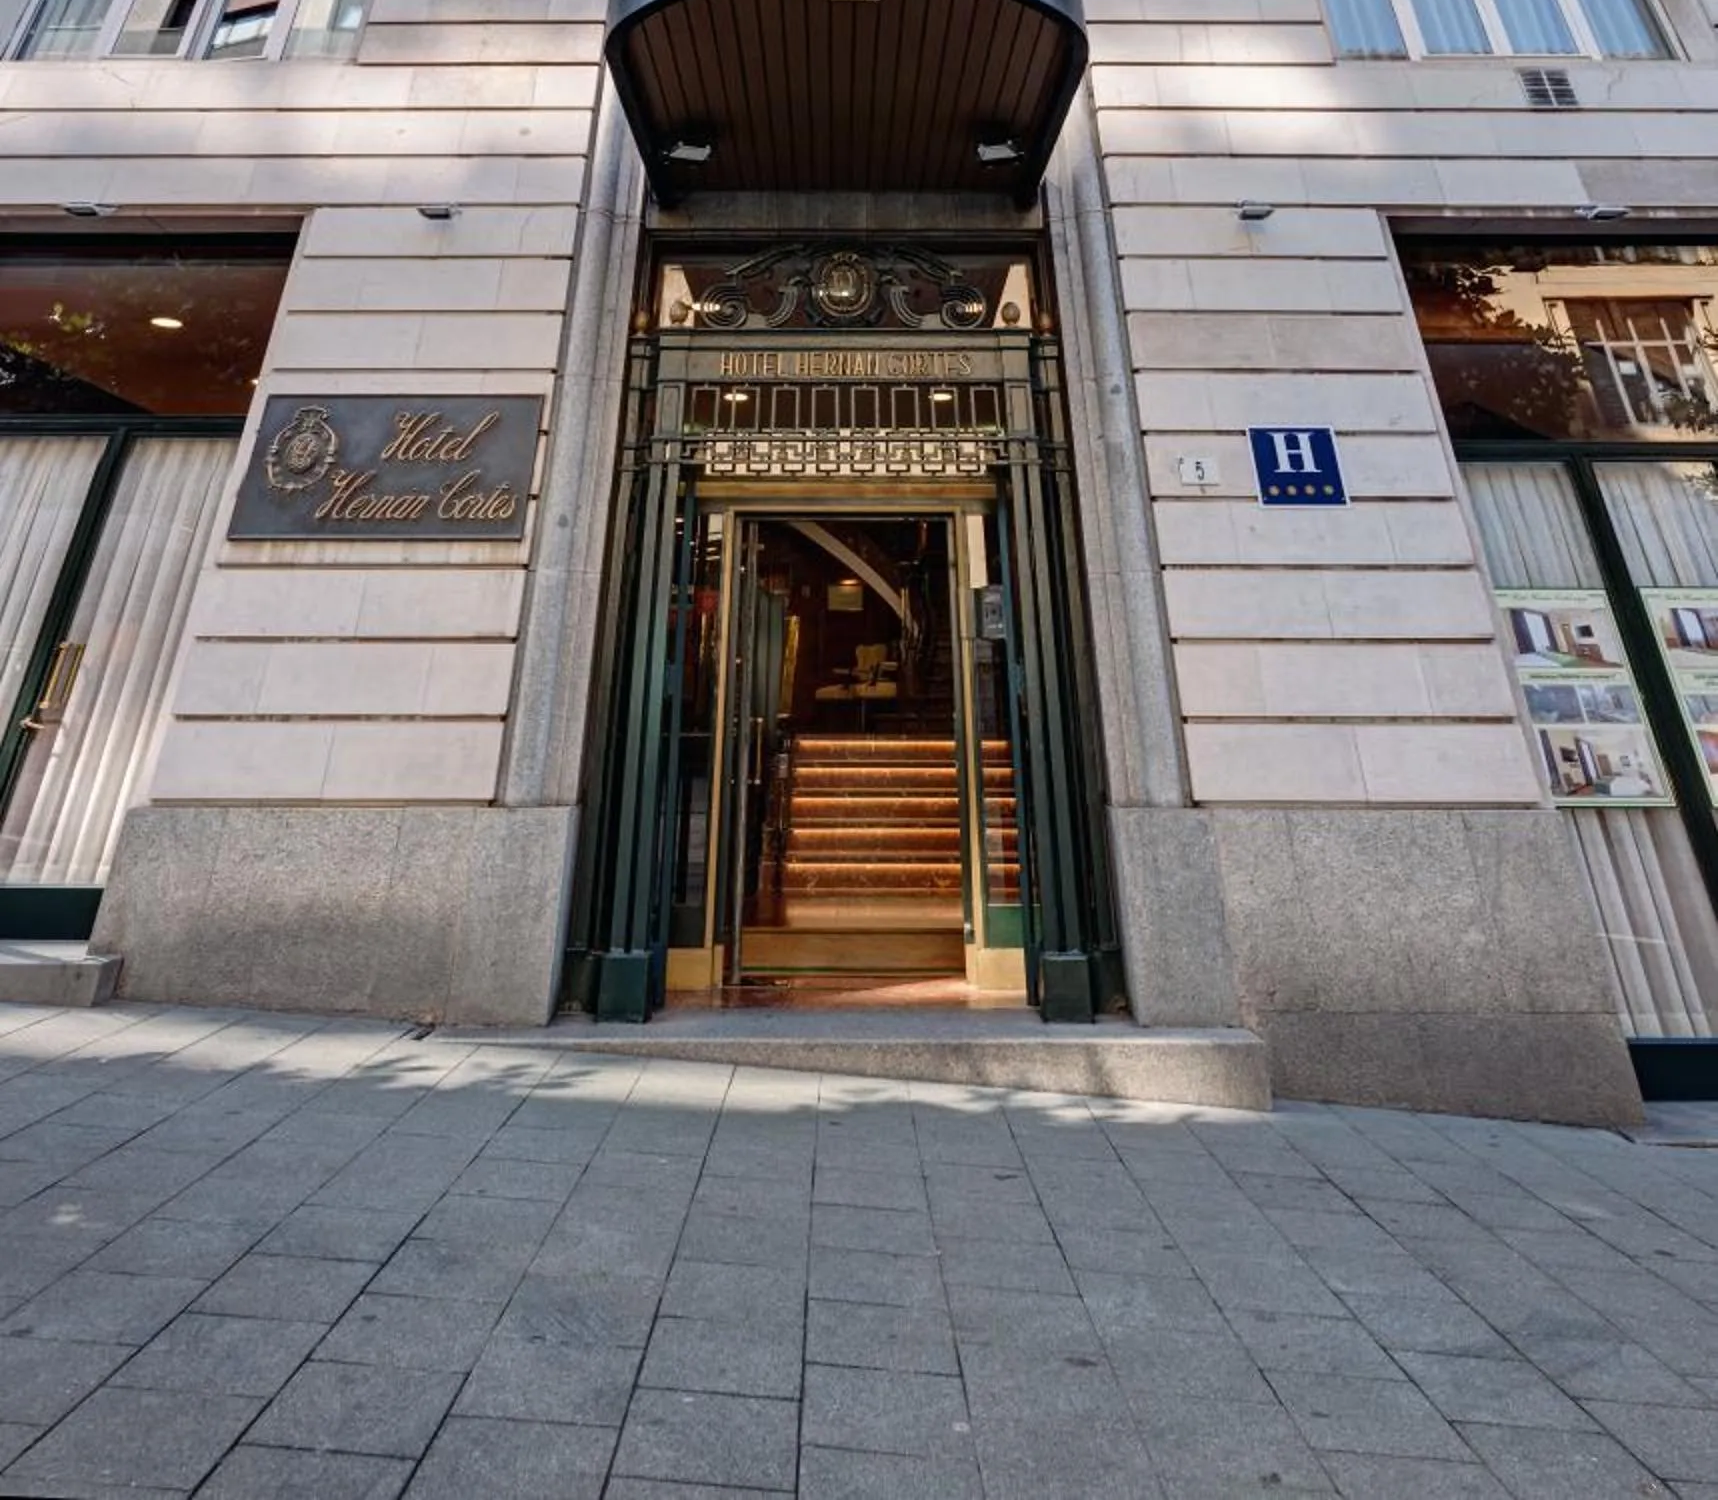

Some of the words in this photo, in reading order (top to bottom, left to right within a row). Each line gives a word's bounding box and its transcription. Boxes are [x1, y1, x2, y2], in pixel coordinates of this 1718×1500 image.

[720, 351, 789, 376] HOTEL
[796, 351, 879, 376] HERNAN
[381, 411, 499, 460] Hotel
[1266, 431, 1322, 473] H
[1195, 461, 1205, 481] 5
